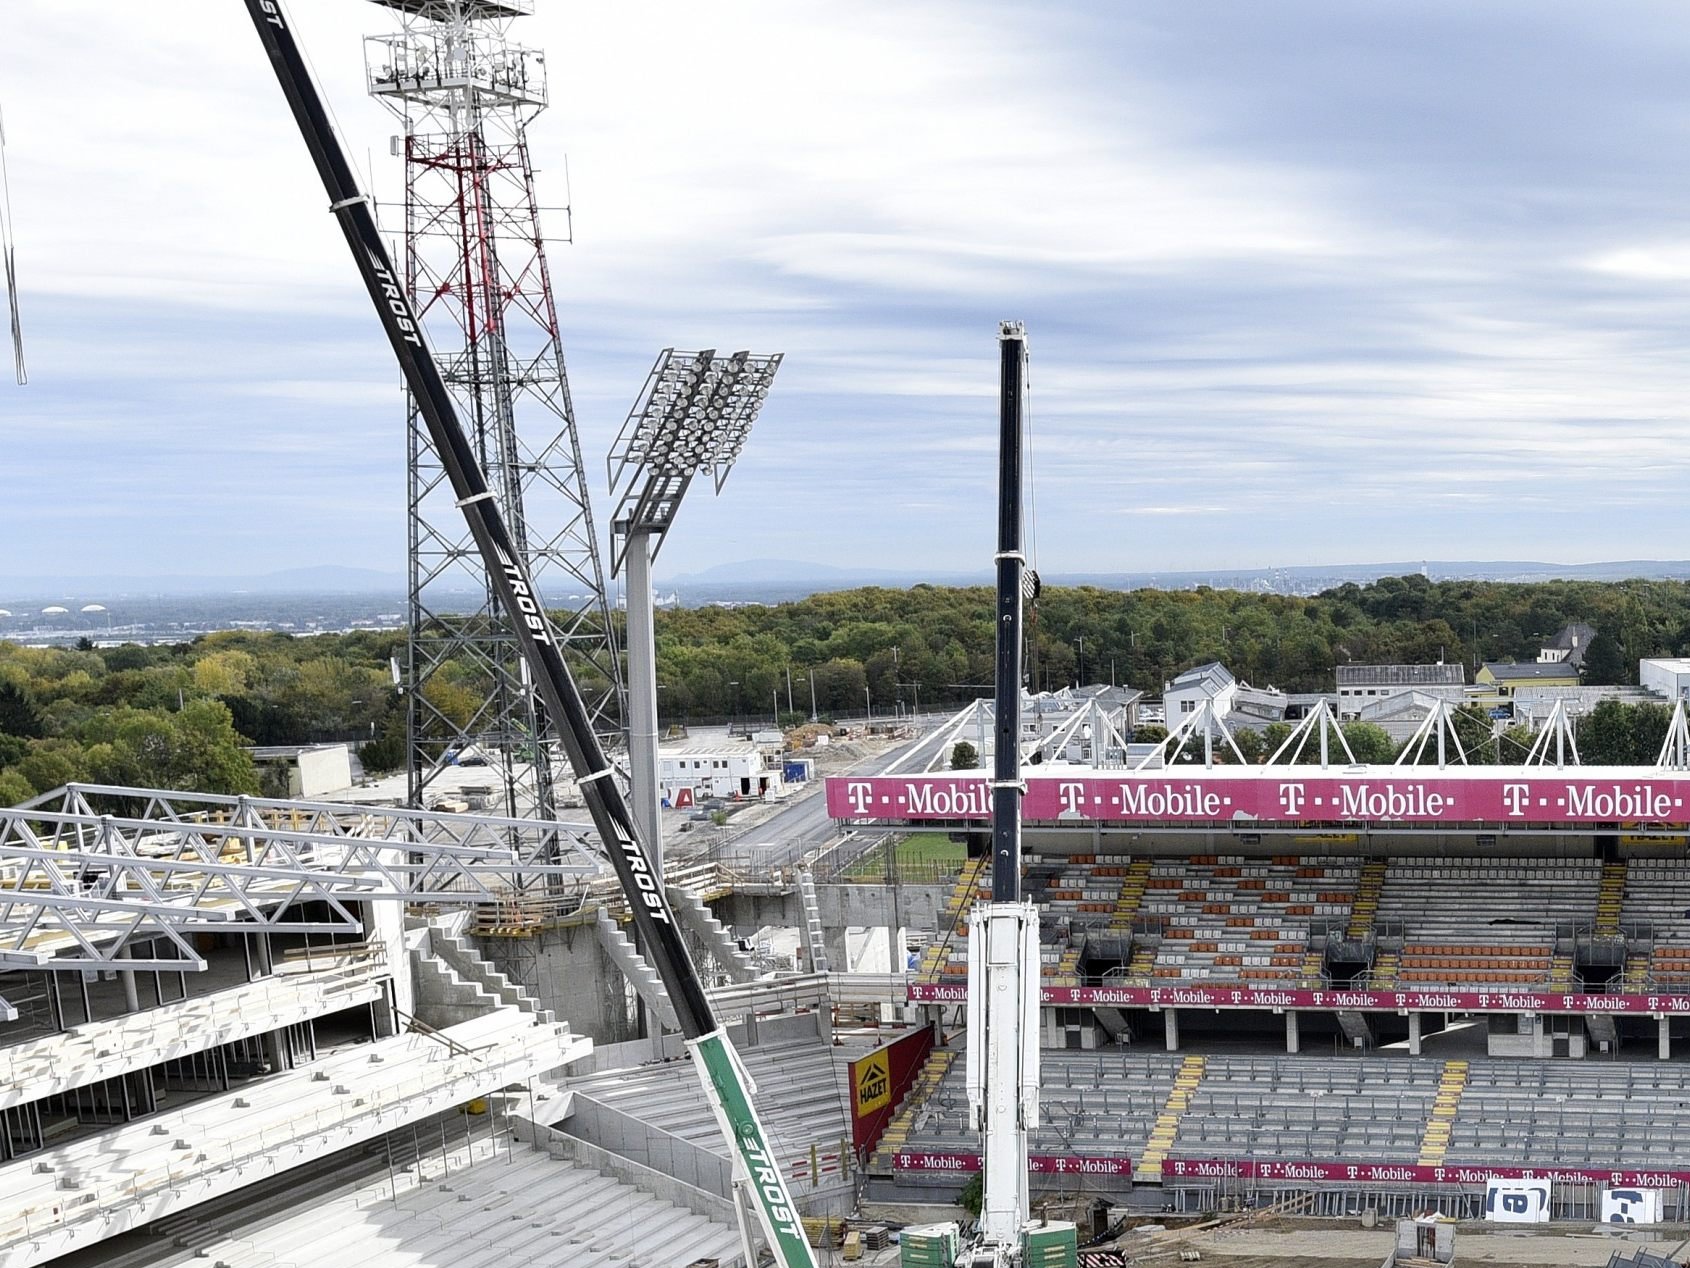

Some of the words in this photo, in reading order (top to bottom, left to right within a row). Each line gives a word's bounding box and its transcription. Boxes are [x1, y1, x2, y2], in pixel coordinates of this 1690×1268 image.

[372, 267, 423, 348] TROST
[503, 563, 549, 647] TROST
[622, 837, 669, 926] TROST
[860, 1078, 887, 1104] HAZET
[749, 1139, 804, 1240] TROST
